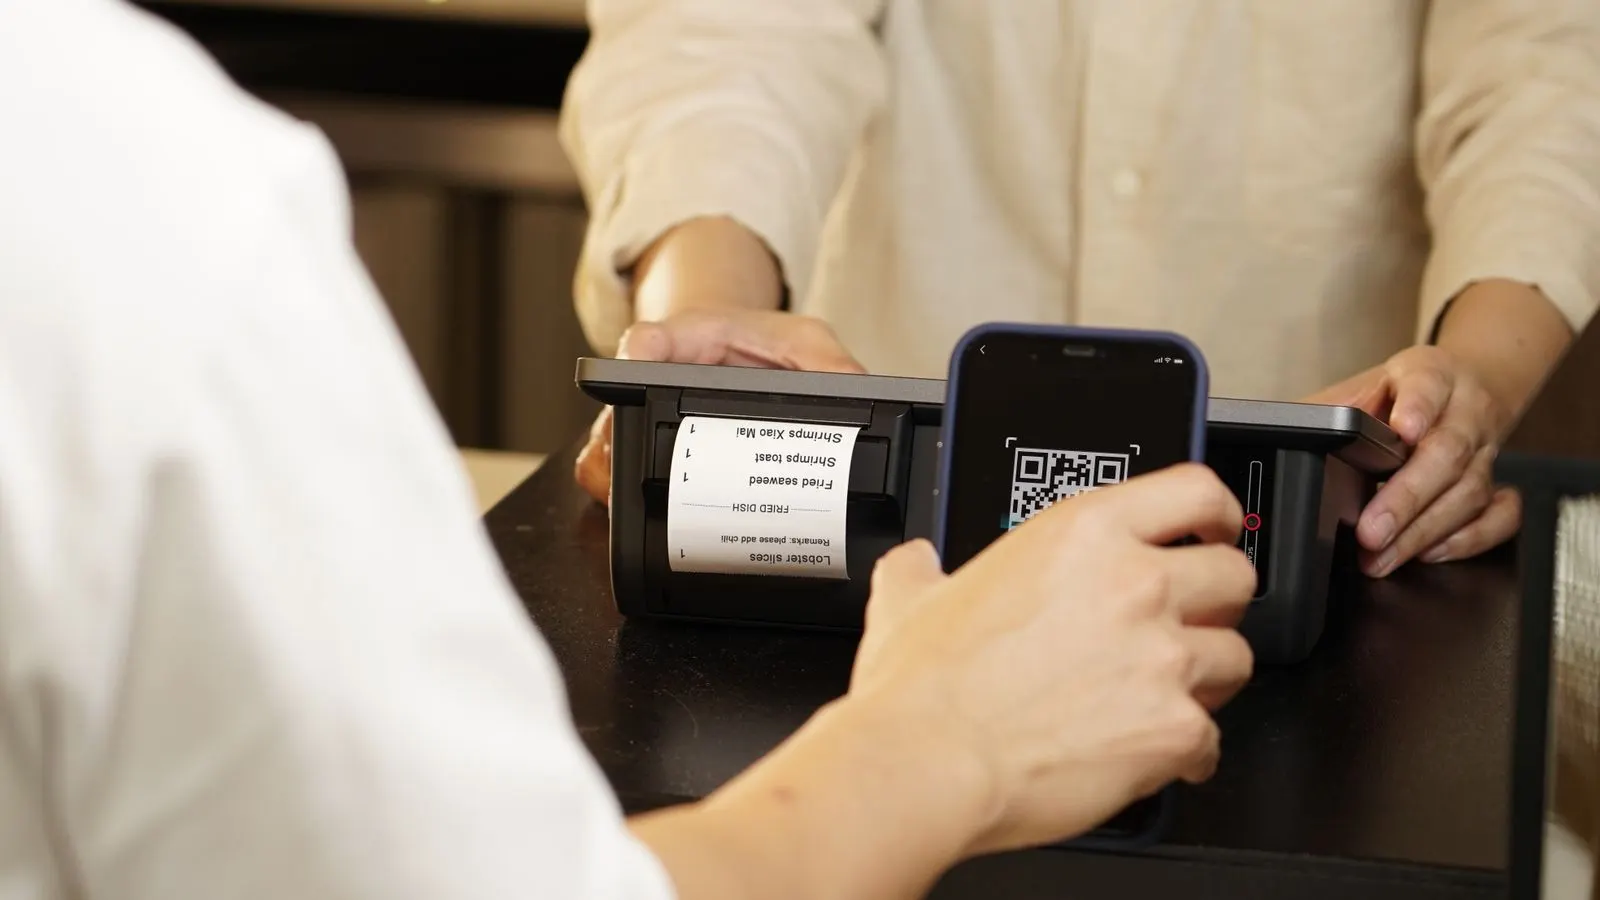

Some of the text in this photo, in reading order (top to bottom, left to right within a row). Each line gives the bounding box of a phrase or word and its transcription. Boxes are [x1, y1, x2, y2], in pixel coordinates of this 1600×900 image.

[689, 423, 843, 444] Shrimps Xiao Mai 1
[685, 448, 837, 468] Shrimps toast 1
[683, 471, 834, 490] Fried seaweed 1
[732, 503, 790, 513] FRIED DISH
[721, 535, 830, 546] Remarks: please add chili
[680, 548, 831, 565] Lobster slices 1
